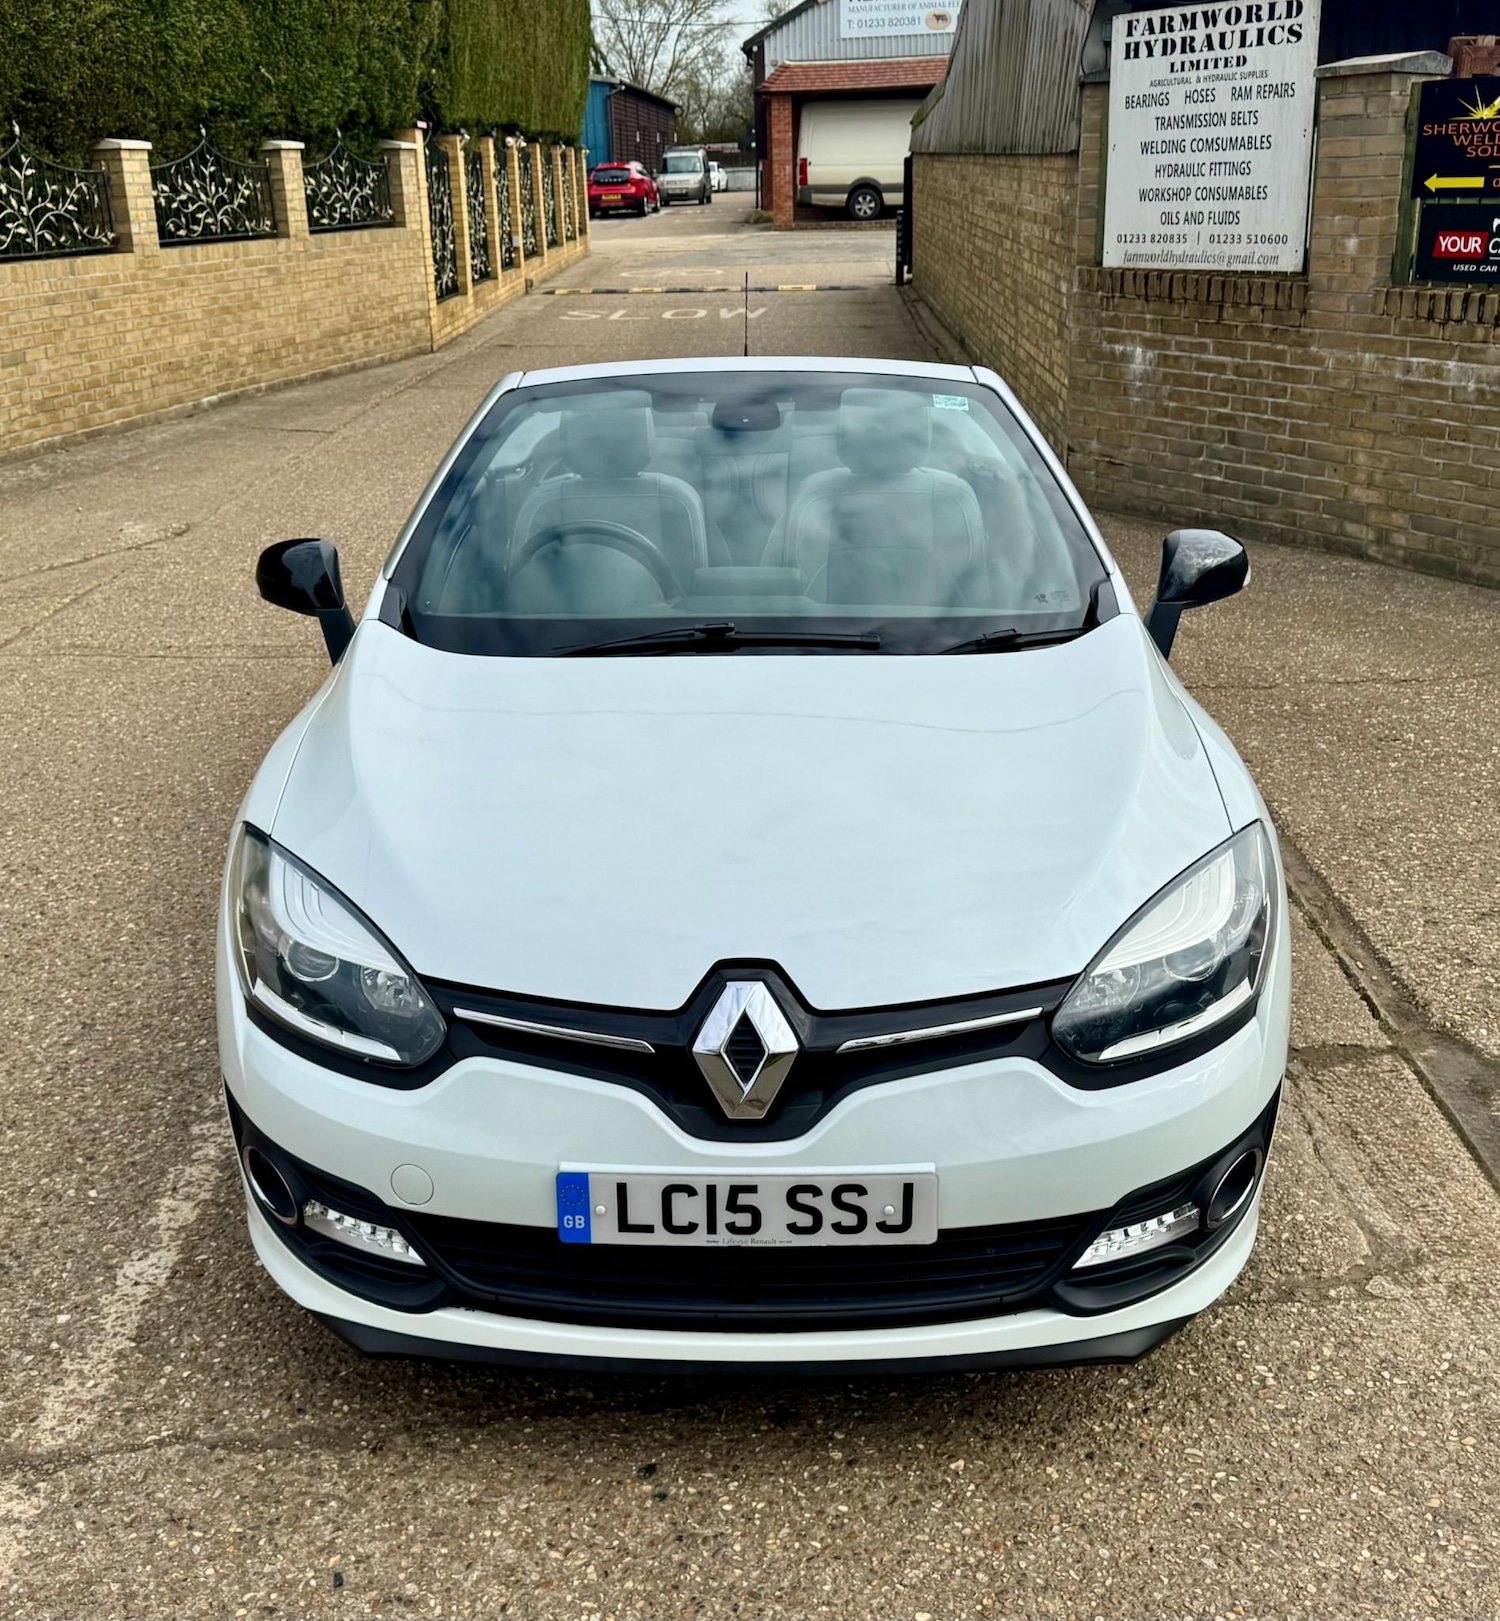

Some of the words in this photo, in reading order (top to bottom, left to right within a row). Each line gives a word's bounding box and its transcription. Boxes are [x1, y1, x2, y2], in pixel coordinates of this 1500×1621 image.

[857, 19, 886, 29] 01233
[888, 17, 921, 27] 820381
[1125, 0, 1303, 37] FARMWORLD
[1123, 23, 1303, 60] HYDRAULICS
[1169, 55, 1247, 73] LIMITED
[1149, 75, 1192, 88] AGRICULTURAL
[1196, 75, 1202, 83] &
[1203, 72, 1238, 83] HYDRAULIC
[1239, 70, 1268, 80] SUPPLIES
[1125, 92, 1170, 110] BEARINGS
[1184, 88, 1216, 105] HOSES
[1230, 85, 1253, 101] RAM
[1256, 82, 1296, 100] REPAIRS
[1155, 112, 1227, 131] TRANSMISSION
[1230, 110, 1259, 127] BELTS
[1140, 139, 1187, 155] WELDING
[1154, 162, 1206, 179] HYDRAULIC
[1209, 160, 1252, 177] FITTINGS
[1138, 187, 1192, 203] WORKSHOP
[1195, 185, 1268, 202] CONSUMABLES
[1160, 211, 1180, 226] OILS
[1183, 211, 1204, 226] AND
[1208, 210, 1241, 226] FLUIDS
[1117, 233, 1147, 244] 01233
[1150, 233, 1188, 244] 820835
[1209, 233, 1242, 244] 01233
[1246, 233, 1288, 245] 510600
[1439, 236, 1482, 253] YOUR
[1123, 249, 1279, 268] farmworldhydraulics@gmail.com
[1453, 264, 1477, 272] USED
[1479, 265, 1498, 273] CAR
[558, 307, 768, 320] SLOW
[616, 1181, 762, 1235] LC15
[786, 1183, 914, 1235] SSJ
[563, 1215, 586, 1229] GB
